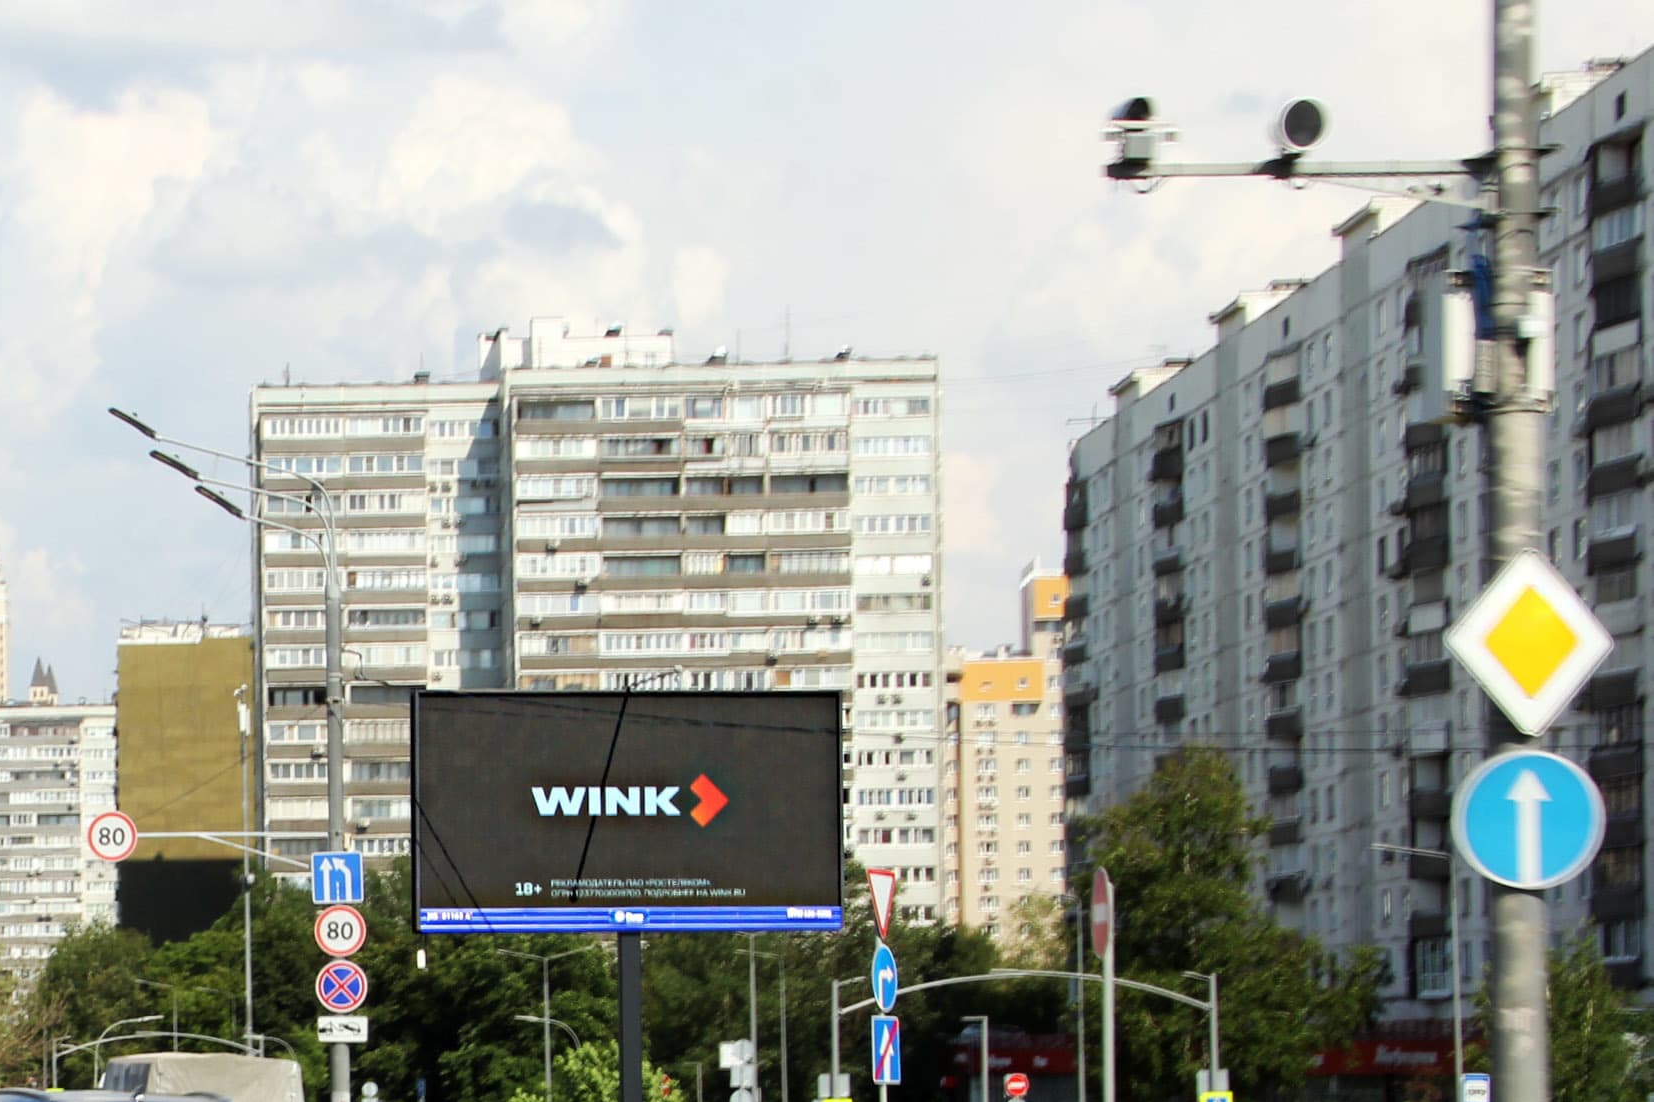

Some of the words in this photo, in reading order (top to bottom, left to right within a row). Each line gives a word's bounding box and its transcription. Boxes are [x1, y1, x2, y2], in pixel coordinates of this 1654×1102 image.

[531, 786, 681, 816] WINK
[98, 828, 125, 846] 80
[515, 882, 542, 896] 18+
[327, 922, 353, 940] 80
